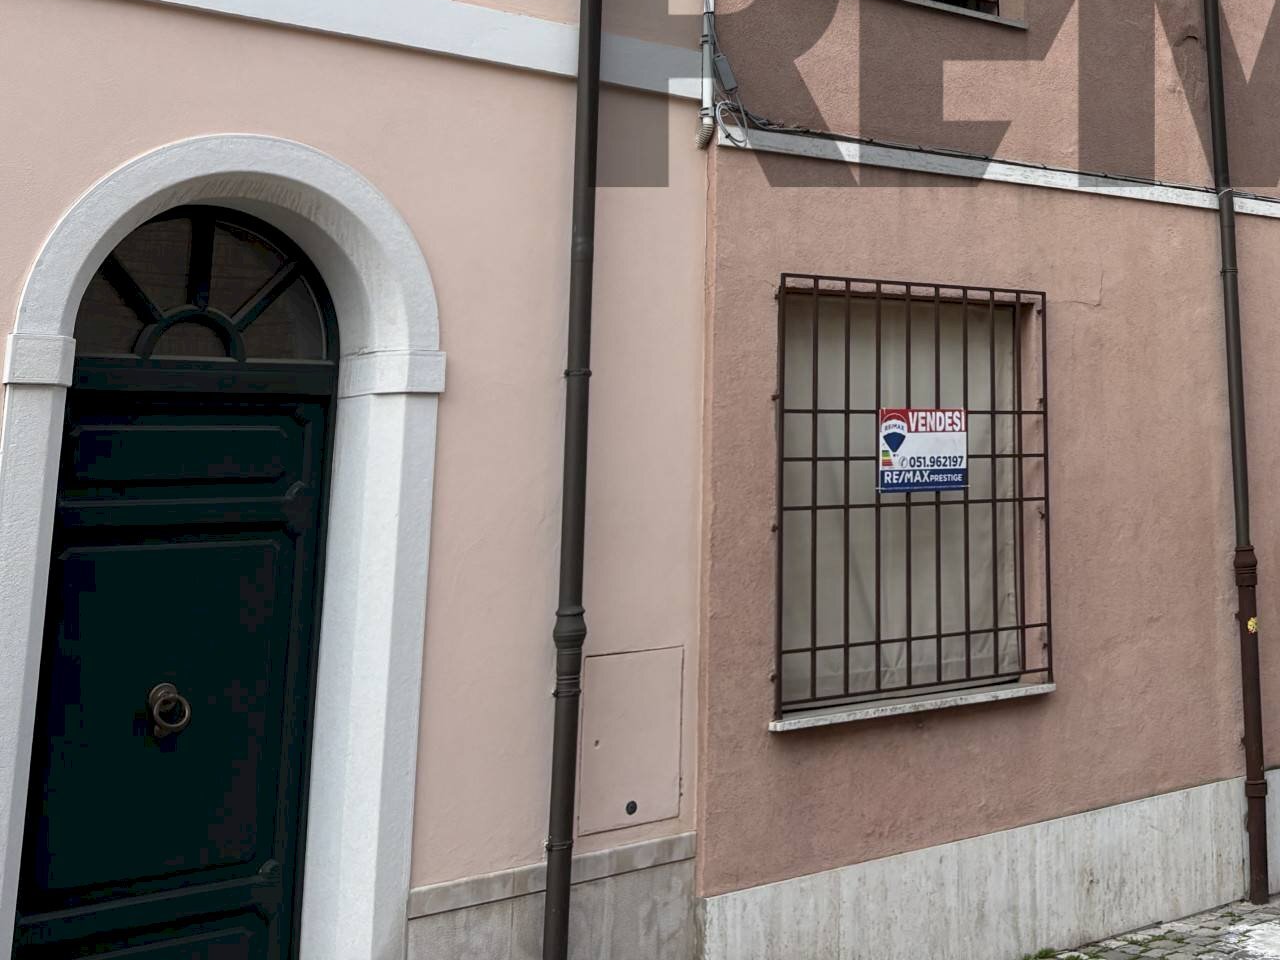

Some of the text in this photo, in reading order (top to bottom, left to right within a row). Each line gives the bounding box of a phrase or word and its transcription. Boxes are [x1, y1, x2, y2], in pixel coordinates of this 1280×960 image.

[908, 411, 965, 432] VENDESI
[909, 456, 963, 468] 051.962197
[884, 470, 963, 483] RE/MAX PRESTIGE
